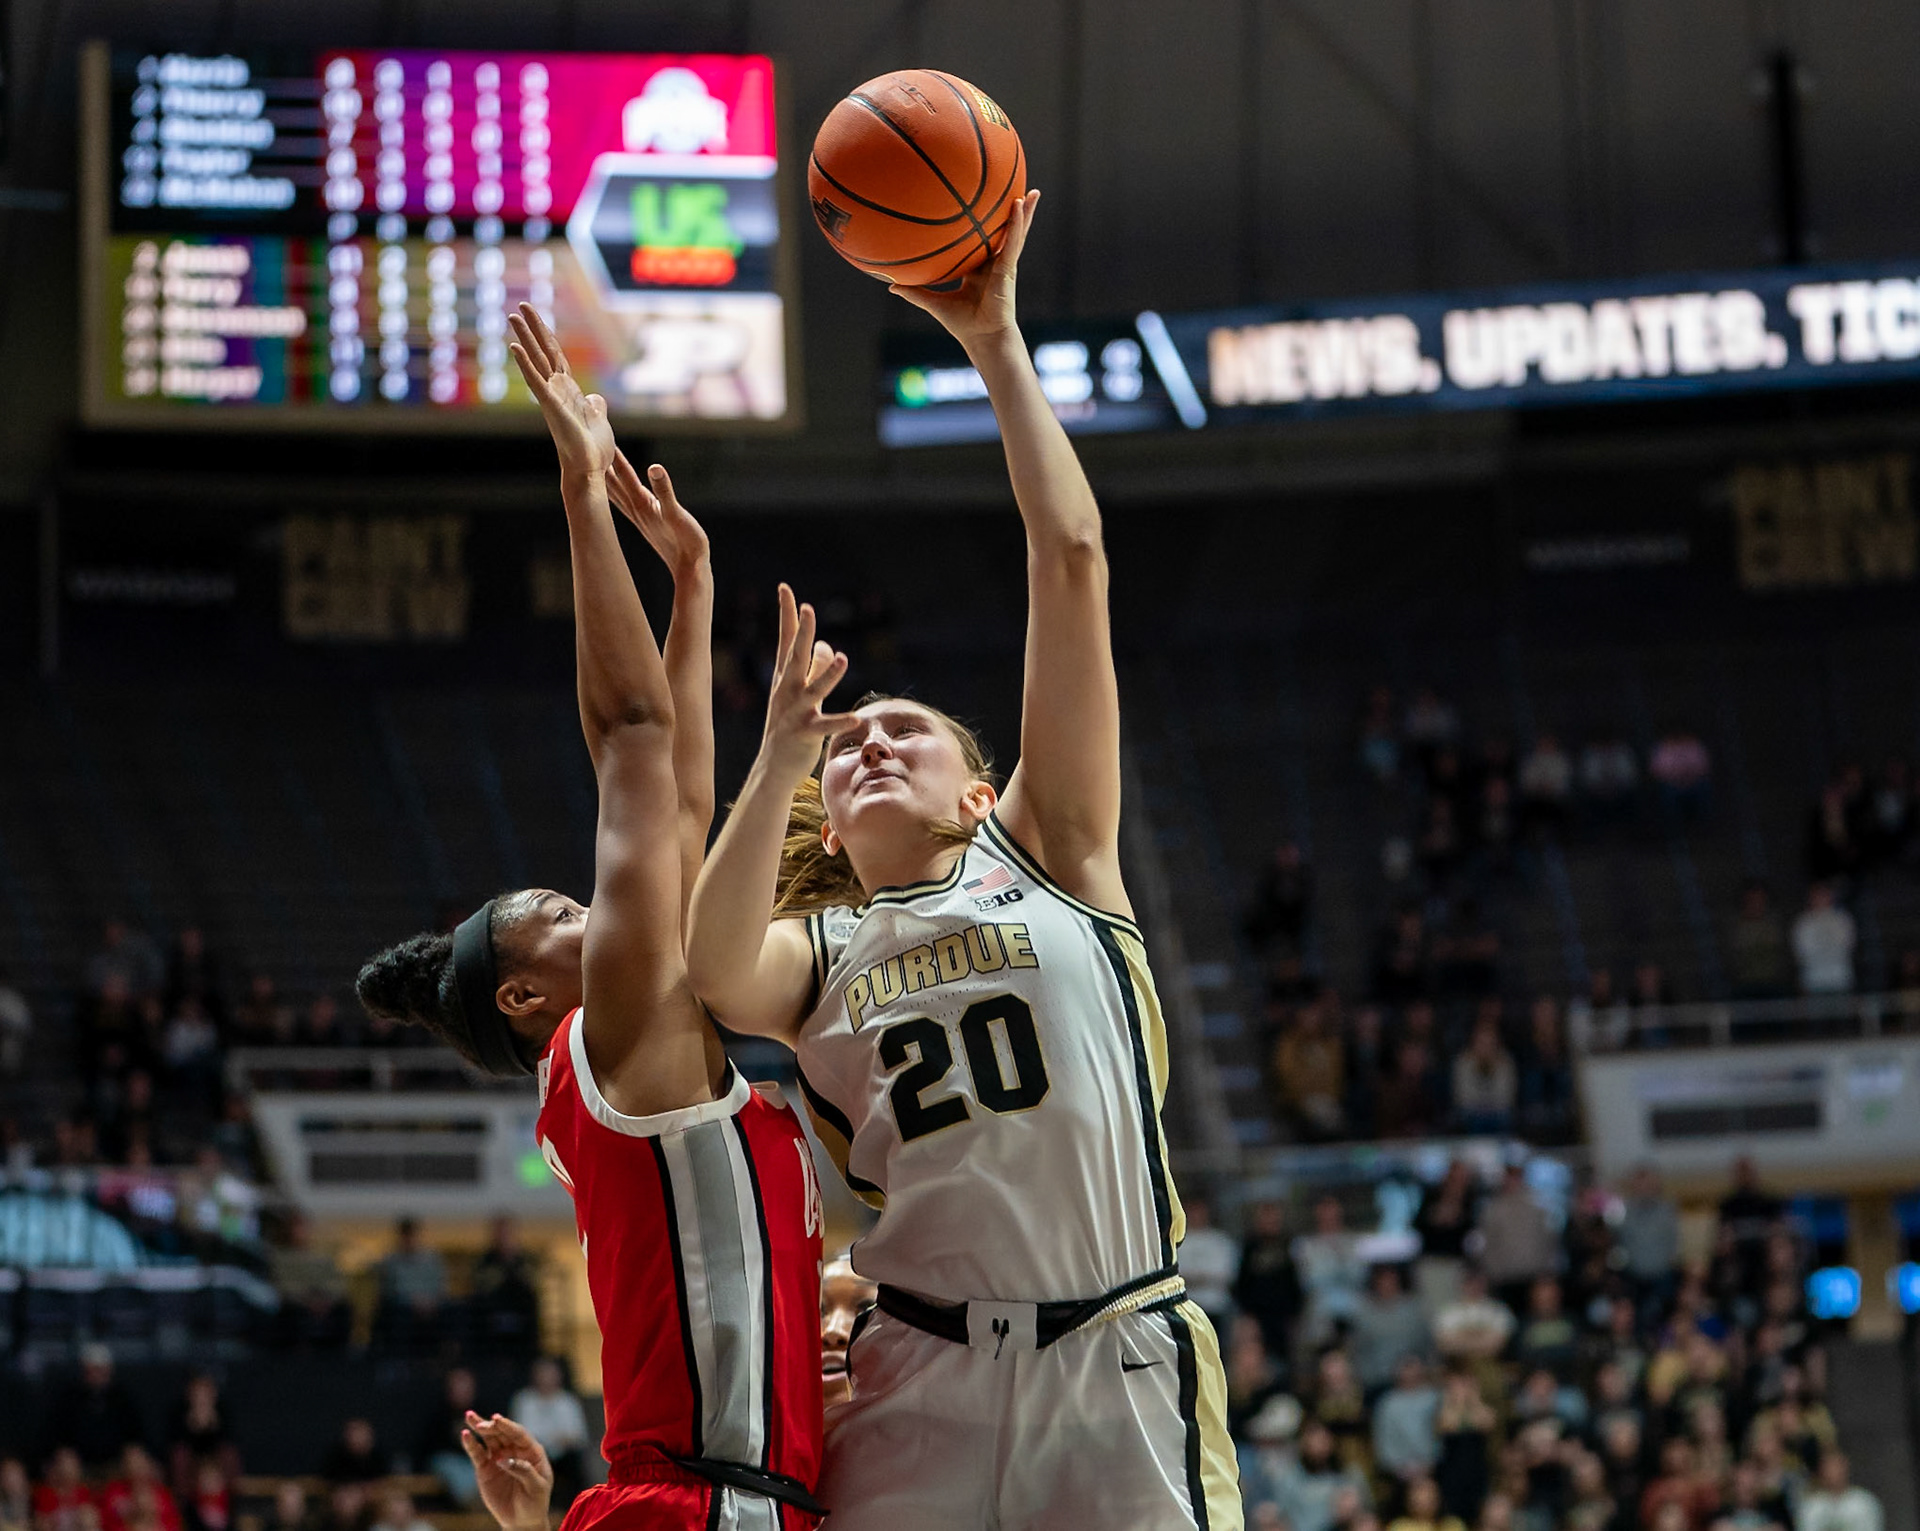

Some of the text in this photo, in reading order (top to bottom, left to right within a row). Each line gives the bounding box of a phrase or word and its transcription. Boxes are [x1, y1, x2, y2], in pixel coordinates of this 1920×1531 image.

[1207, 313, 1443, 406] NEWS.
[1443, 288, 1788, 390] UPDATES.
[1788, 277, 1920, 366] TIC
[843, 923, 1040, 1035] PURDUE
[878, 992, 1050, 1145] 20
